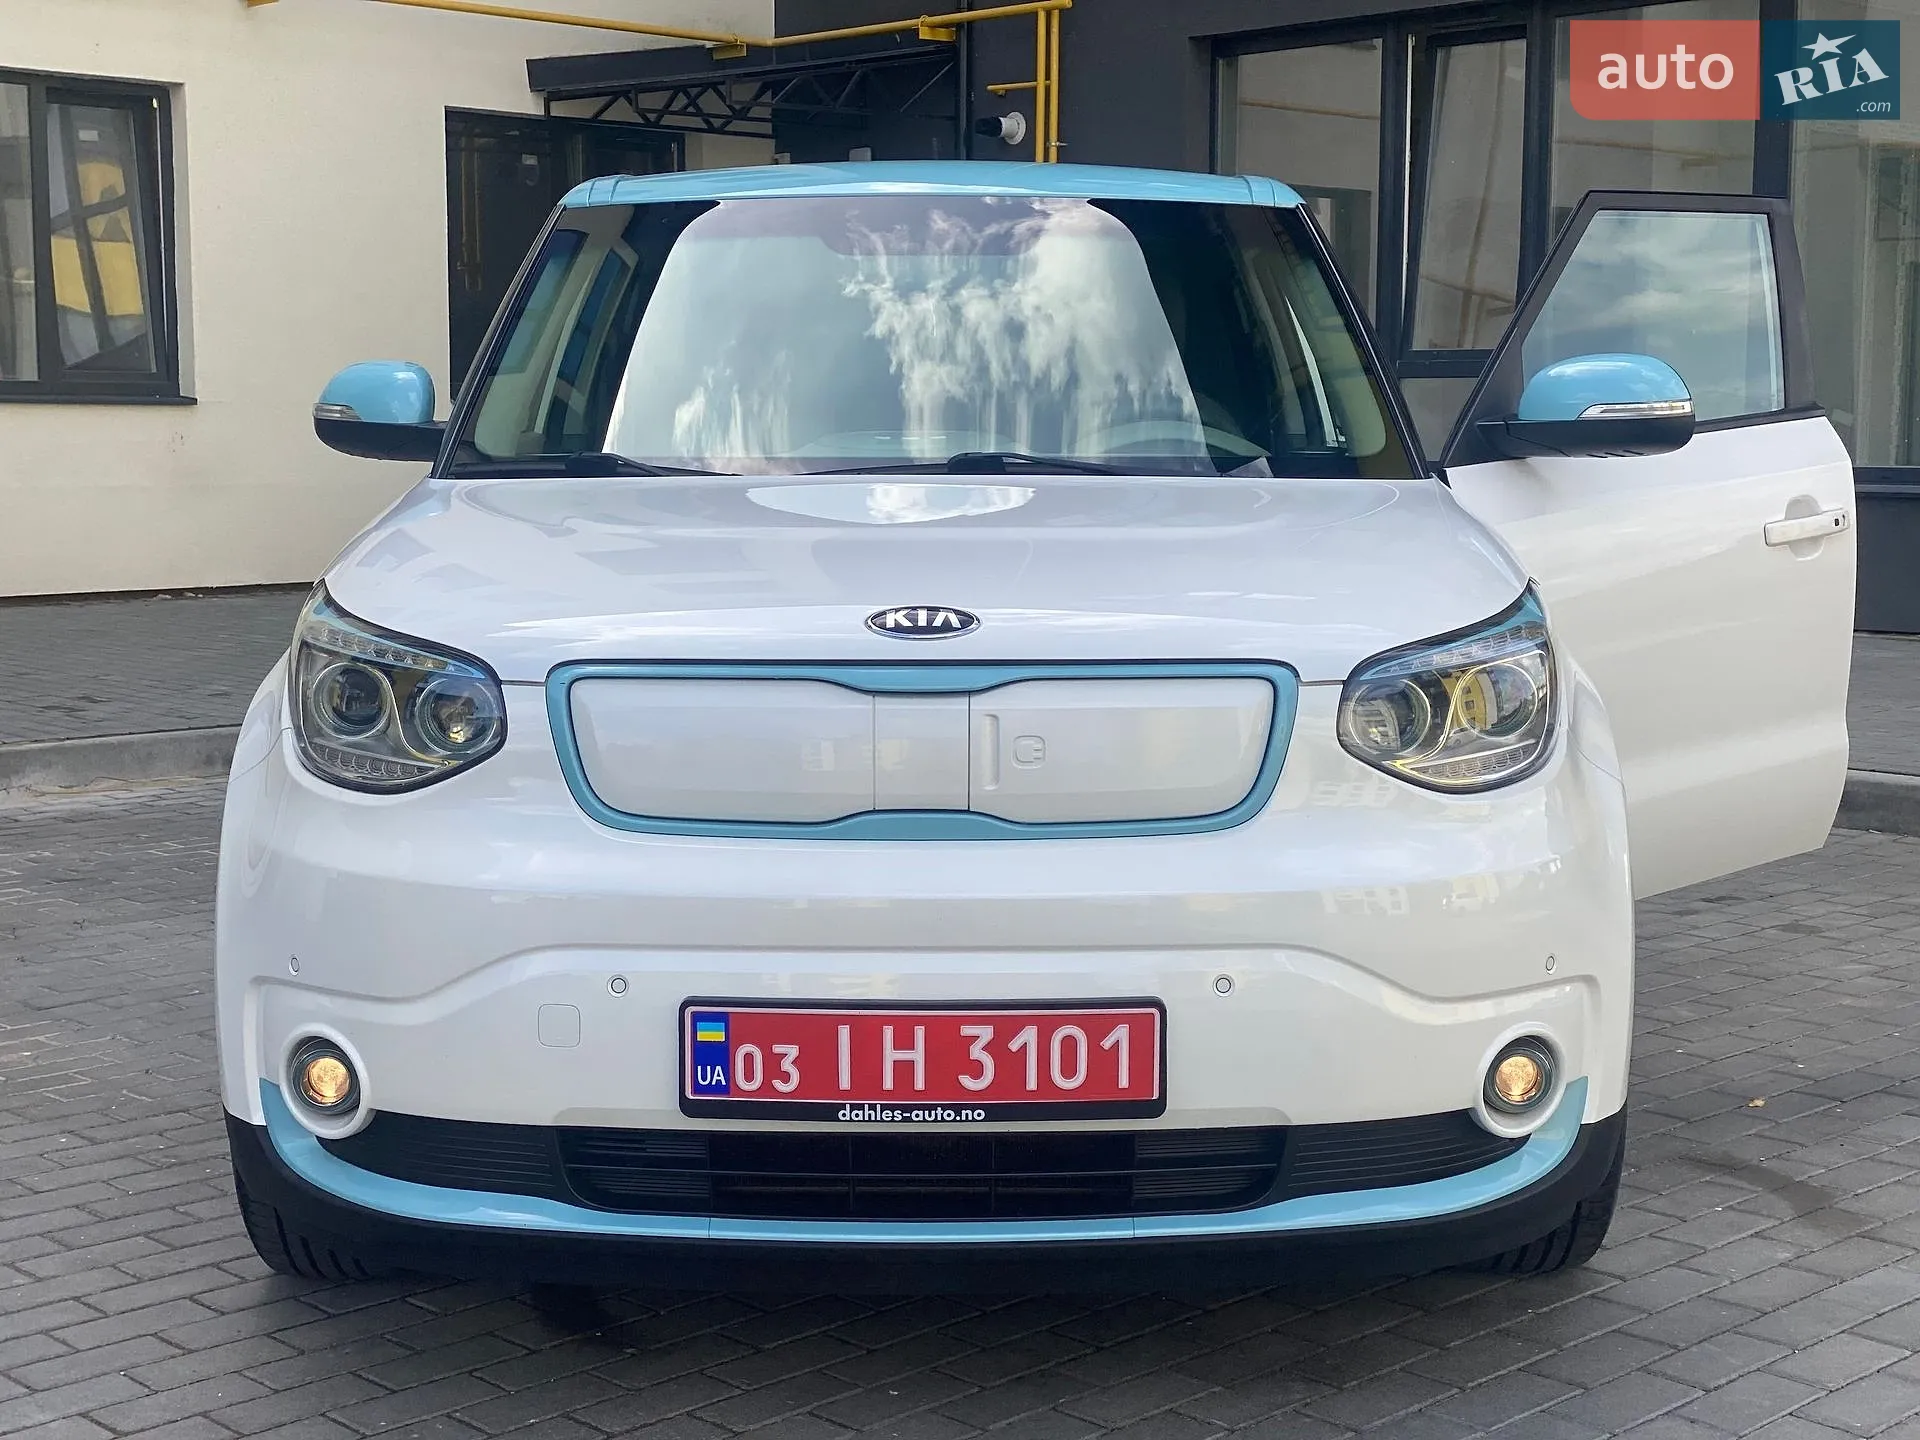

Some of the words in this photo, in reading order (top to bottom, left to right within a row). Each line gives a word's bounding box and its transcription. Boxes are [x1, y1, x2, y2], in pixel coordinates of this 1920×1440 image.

[885, 608, 962, 628] KIA
[734, 1043, 800, 1093] 03
[958, 1025, 1130, 1091] 3101
[697, 1065, 726, 1086] UA
[838, 1103, 986, 1122] dahles-auto.no
